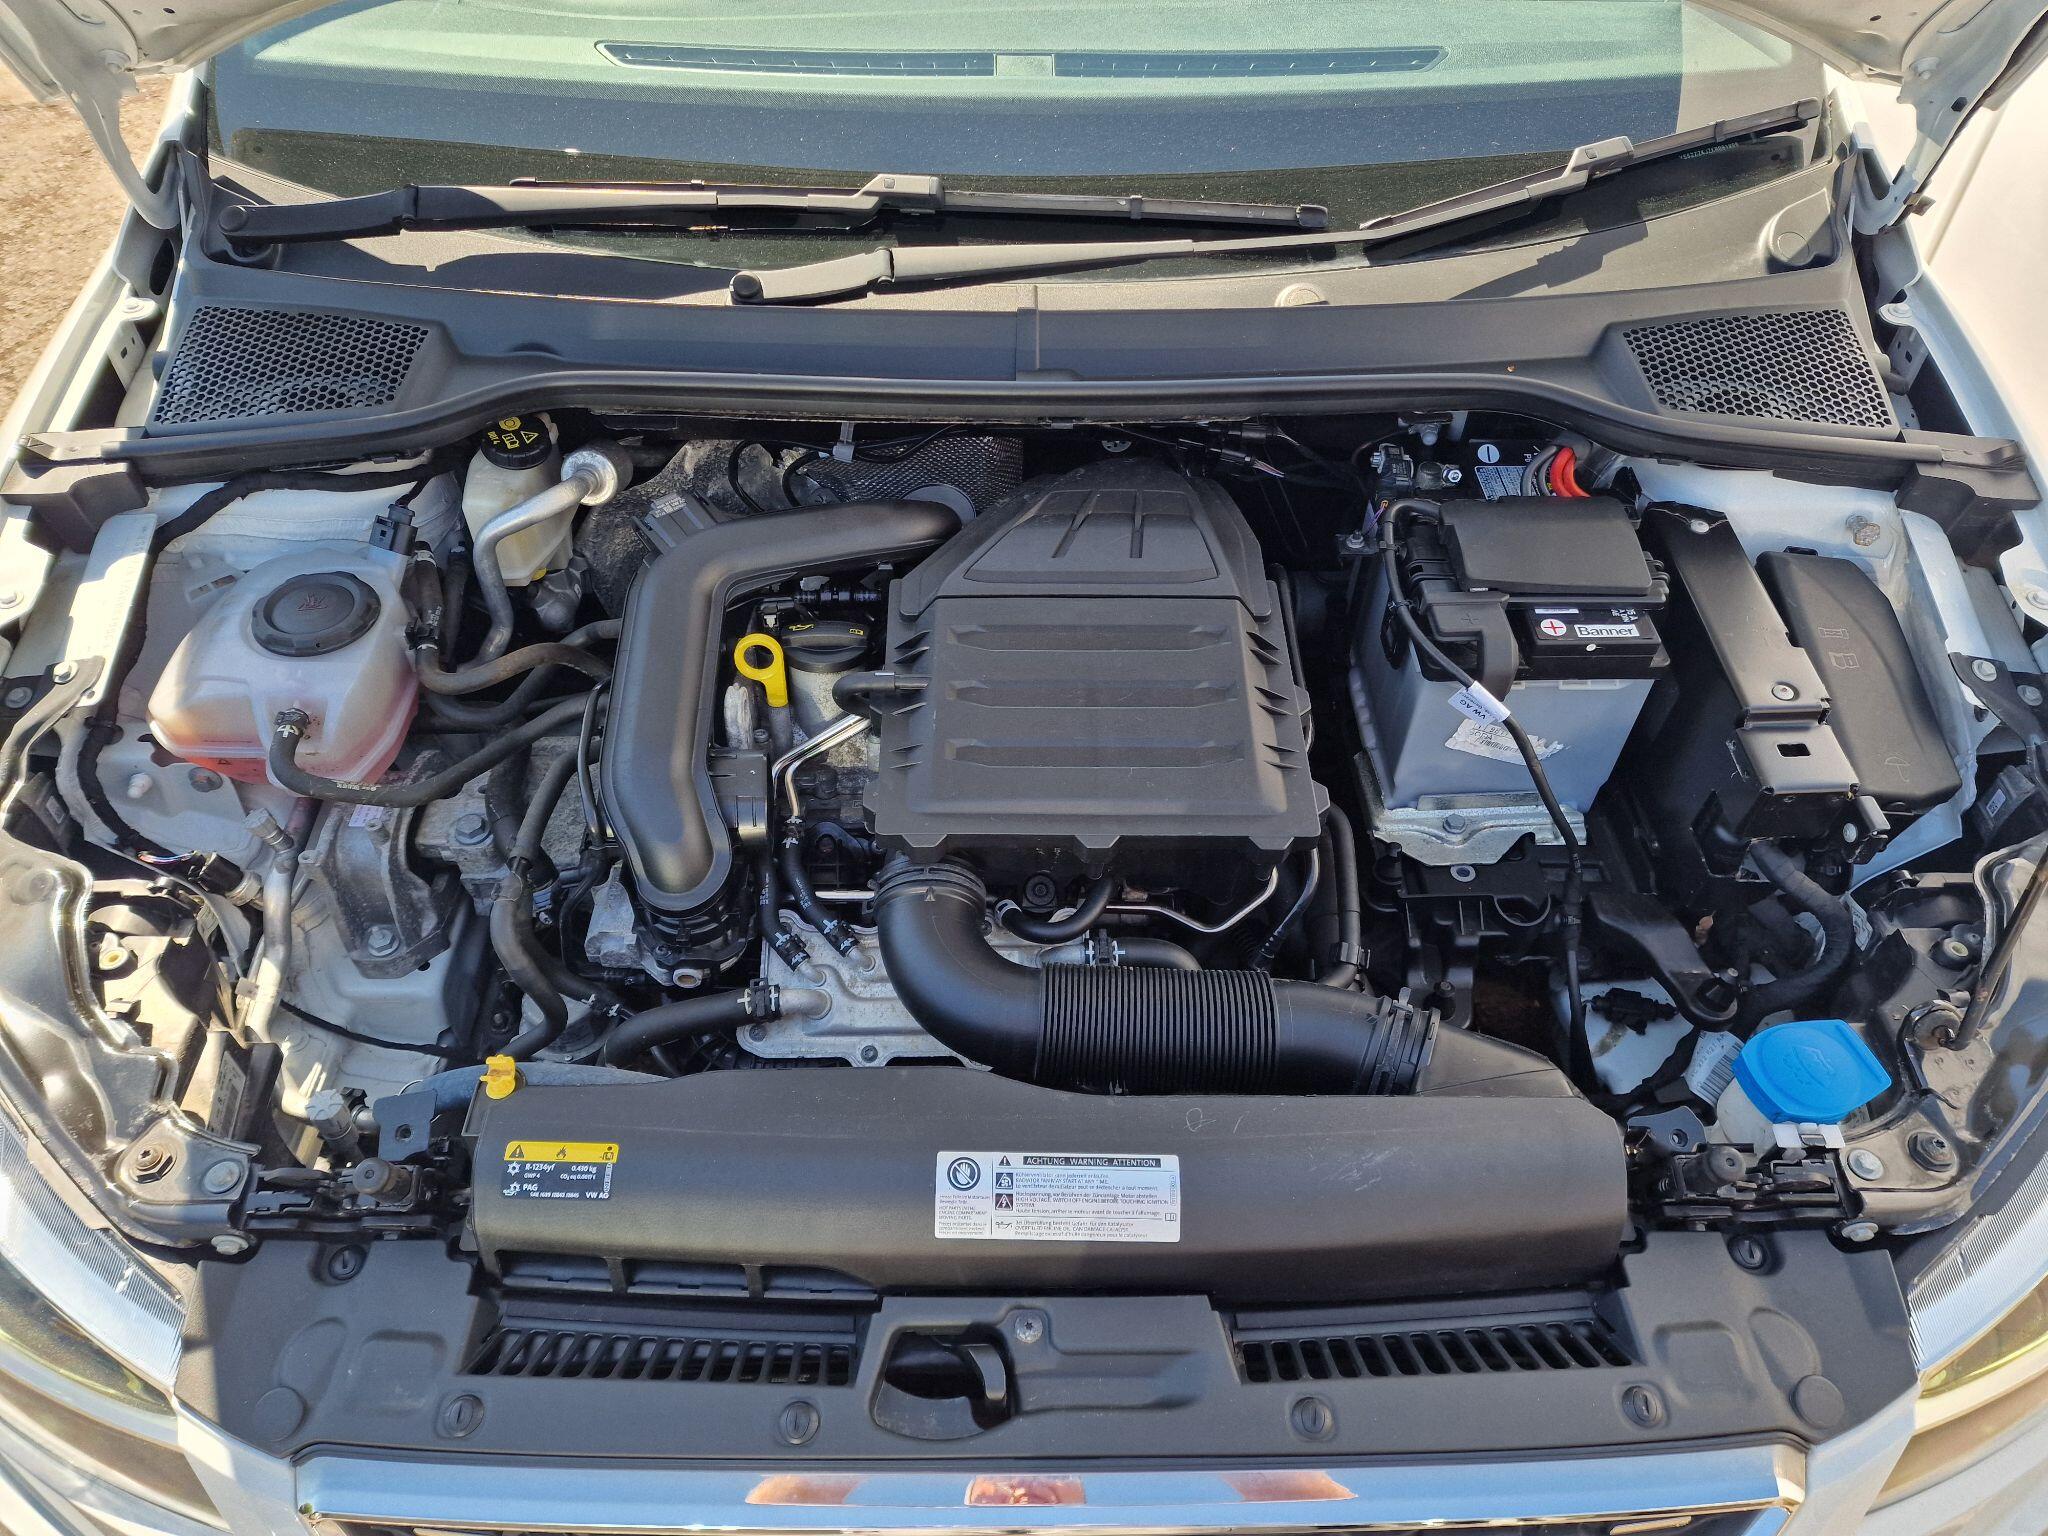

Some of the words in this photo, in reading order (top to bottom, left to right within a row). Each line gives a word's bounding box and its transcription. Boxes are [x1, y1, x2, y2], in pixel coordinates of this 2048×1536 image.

[1580, 626, 1634, 636] Banner
[1027, 1158, 1065, 1166] ACHTUNG
[1069, 1158, 1109, 1166] WARNING
[1112, 1159, 1156, 1167] ATTENTION
[525, 1163, 555, 1173] R-1234yf
[589, 1165, 597, 1173] kg
